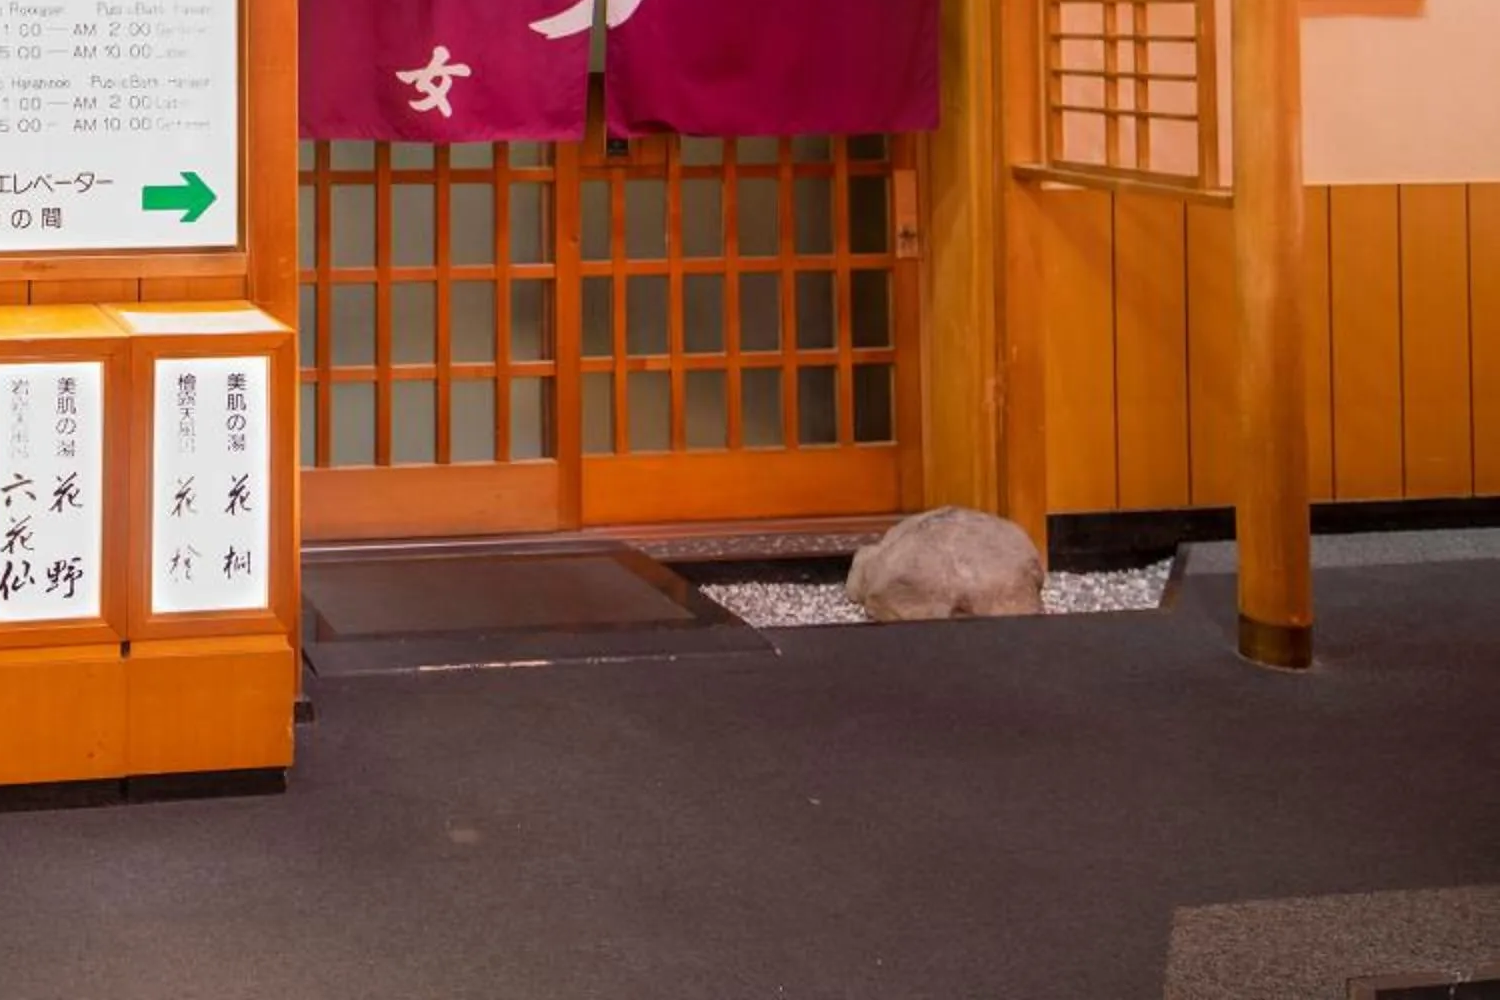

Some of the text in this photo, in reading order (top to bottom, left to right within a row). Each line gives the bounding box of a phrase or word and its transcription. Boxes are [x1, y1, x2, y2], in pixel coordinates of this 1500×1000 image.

[73, 23, 97, 37] AM
[73, 45, 97, 60] AM
[395, 45, 472, 118] 女
[73, 96, 97, 111] AM
[73, 118, 97, 132] AM
[225, 373, 247, 452] 美肌の湯
